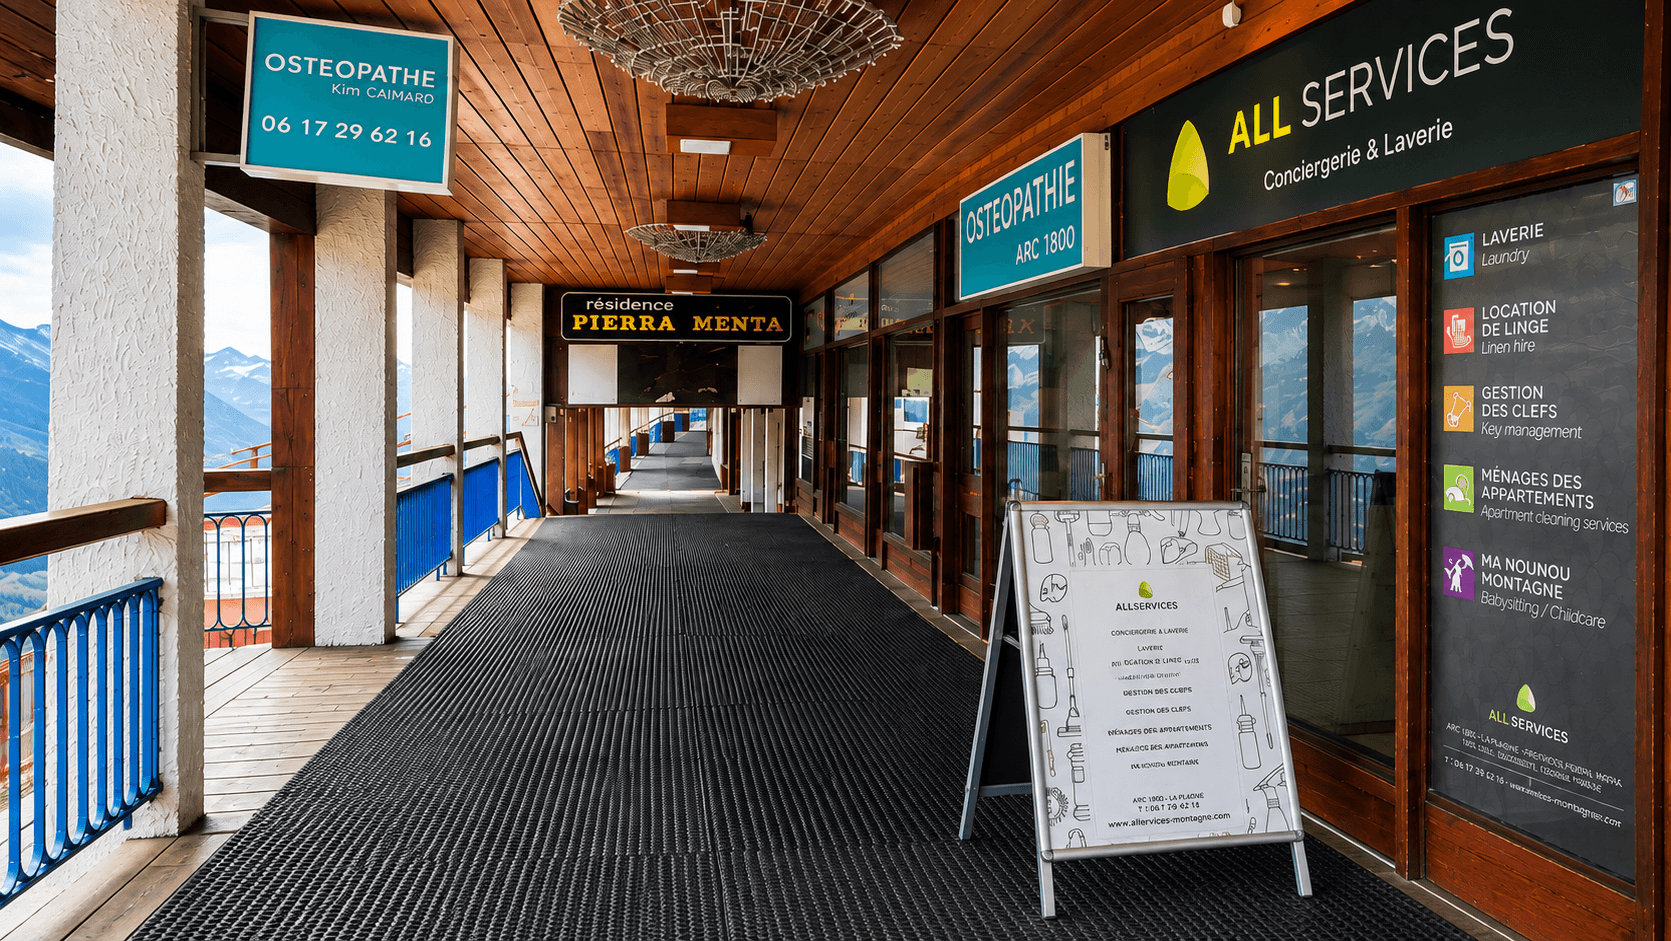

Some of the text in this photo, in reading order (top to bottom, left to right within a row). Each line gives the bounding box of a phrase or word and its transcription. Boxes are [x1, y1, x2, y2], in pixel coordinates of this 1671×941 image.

[264, 53, 436, 88] OSTEOPATHE
[1228, 7, 1515, 154] ALL SERVICES
[332, 83, 360, 96] Kim
[262, 115, 432, 147] 06 17 29 62 16
[1264, 118, 1453, 191] Conciergerie & Laverie
[966, 159, 1075, 244] OSTEOPATHIE
[1016, 225, 1075, 265] ARC 1800
[1482, 222, 1544, 246] LAVERIE
[1482, 248, 1530, 267] Laundry
[586, 297, 674, 311] résidence
[1482, 300, 1556, 320] LOCATION
[572, 314, 784, 332] PIERRA MENTA
[1482, 318, 1549, 336] DE LINGE
[1482, 338, 1536, 354] Linen hire
[1481, 386, 1544, 400] GESTION
[1482, 404, 1558, 419] DES CLEFS
[1481, 422, 1582, 440] Key management
[1481, 466, 1582, 490] MÉNAGES DES
[1481, 485, 1594, 510] APPARTEMENTS
[1481, 504, 1629, 534] Apartment cleaning services
[1481, 554, 1570, 581] MA NOUNOU
[1481, 572, 1563, 600] MONTAGNE
[1489, 709, 1569, 744] ALL SERVICES
